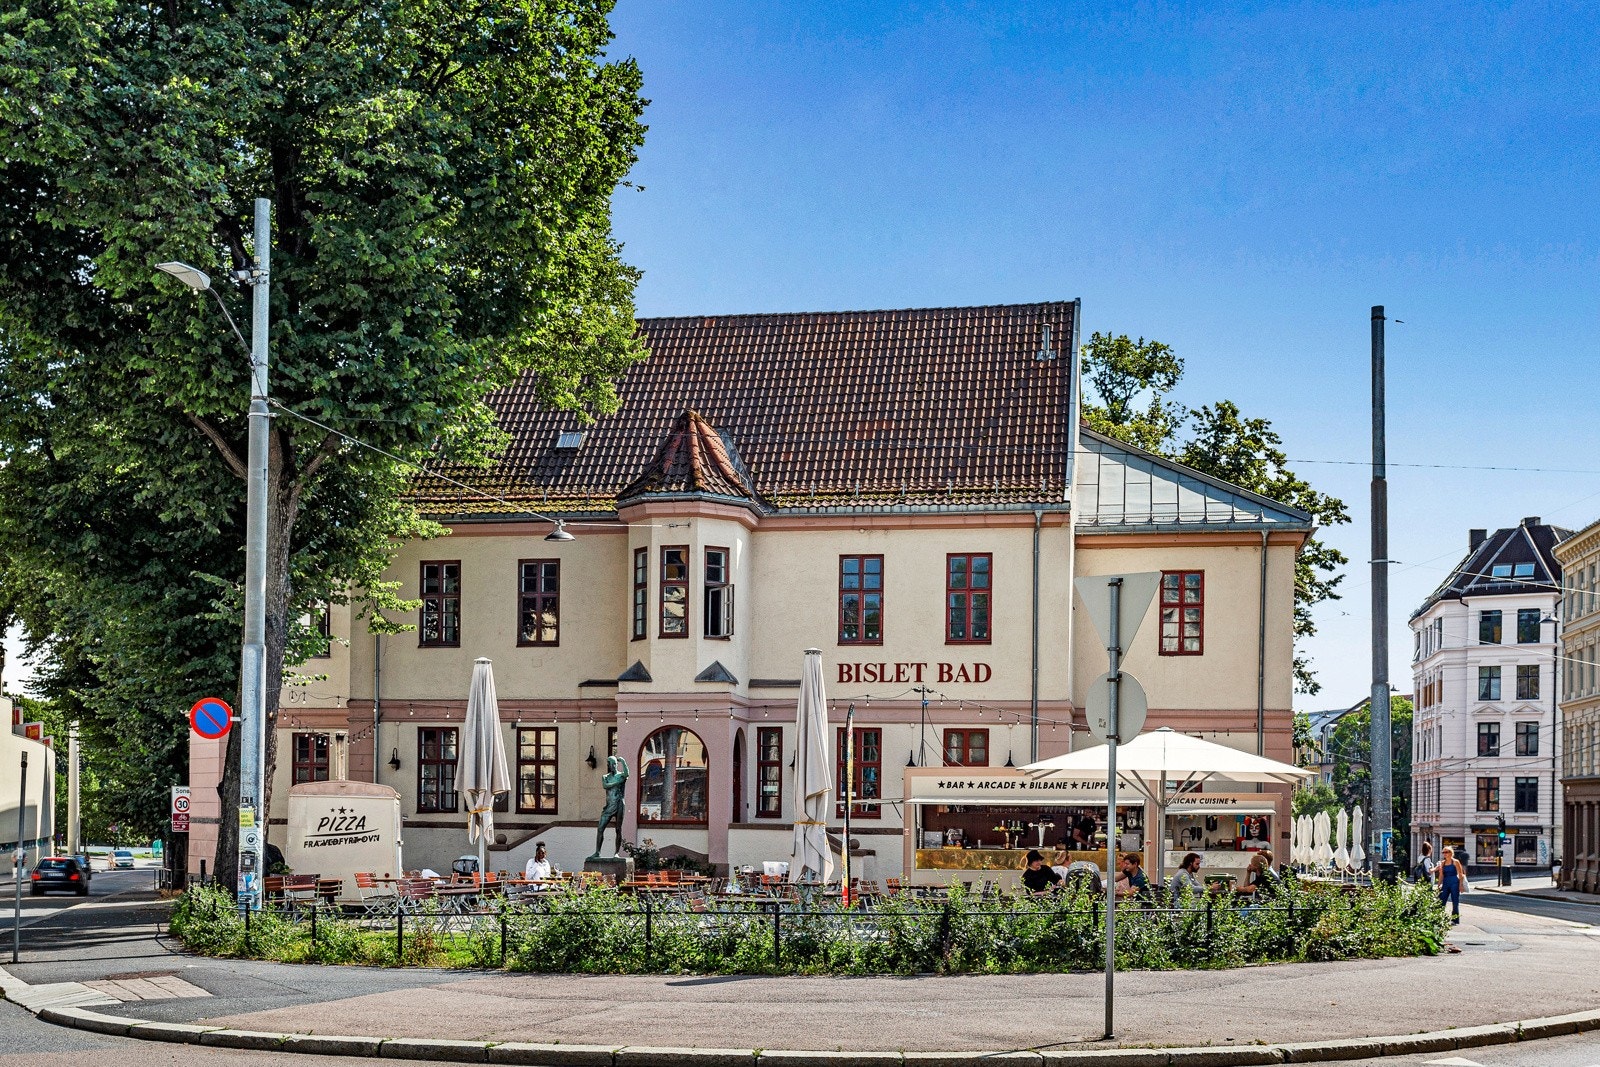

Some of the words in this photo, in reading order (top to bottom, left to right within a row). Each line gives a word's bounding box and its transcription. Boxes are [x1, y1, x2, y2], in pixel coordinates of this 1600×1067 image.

[836, 663, 928, 683] BISLET
[937, 663, 992, 683] BAD
[946, 781, 965, 789] BAR
[977, 781, 1016, 789] ARCADE
[1029, 781, 1068, 790] BILBANE
[1081, 782, 1109, 790] FLIPPE
[177, 800, 188, 809] 30
[1199, 797, 1229, 805] CUISINE
[317, 815, 366, 832] PIZZA
[361, 834, 380, 843] OVN
